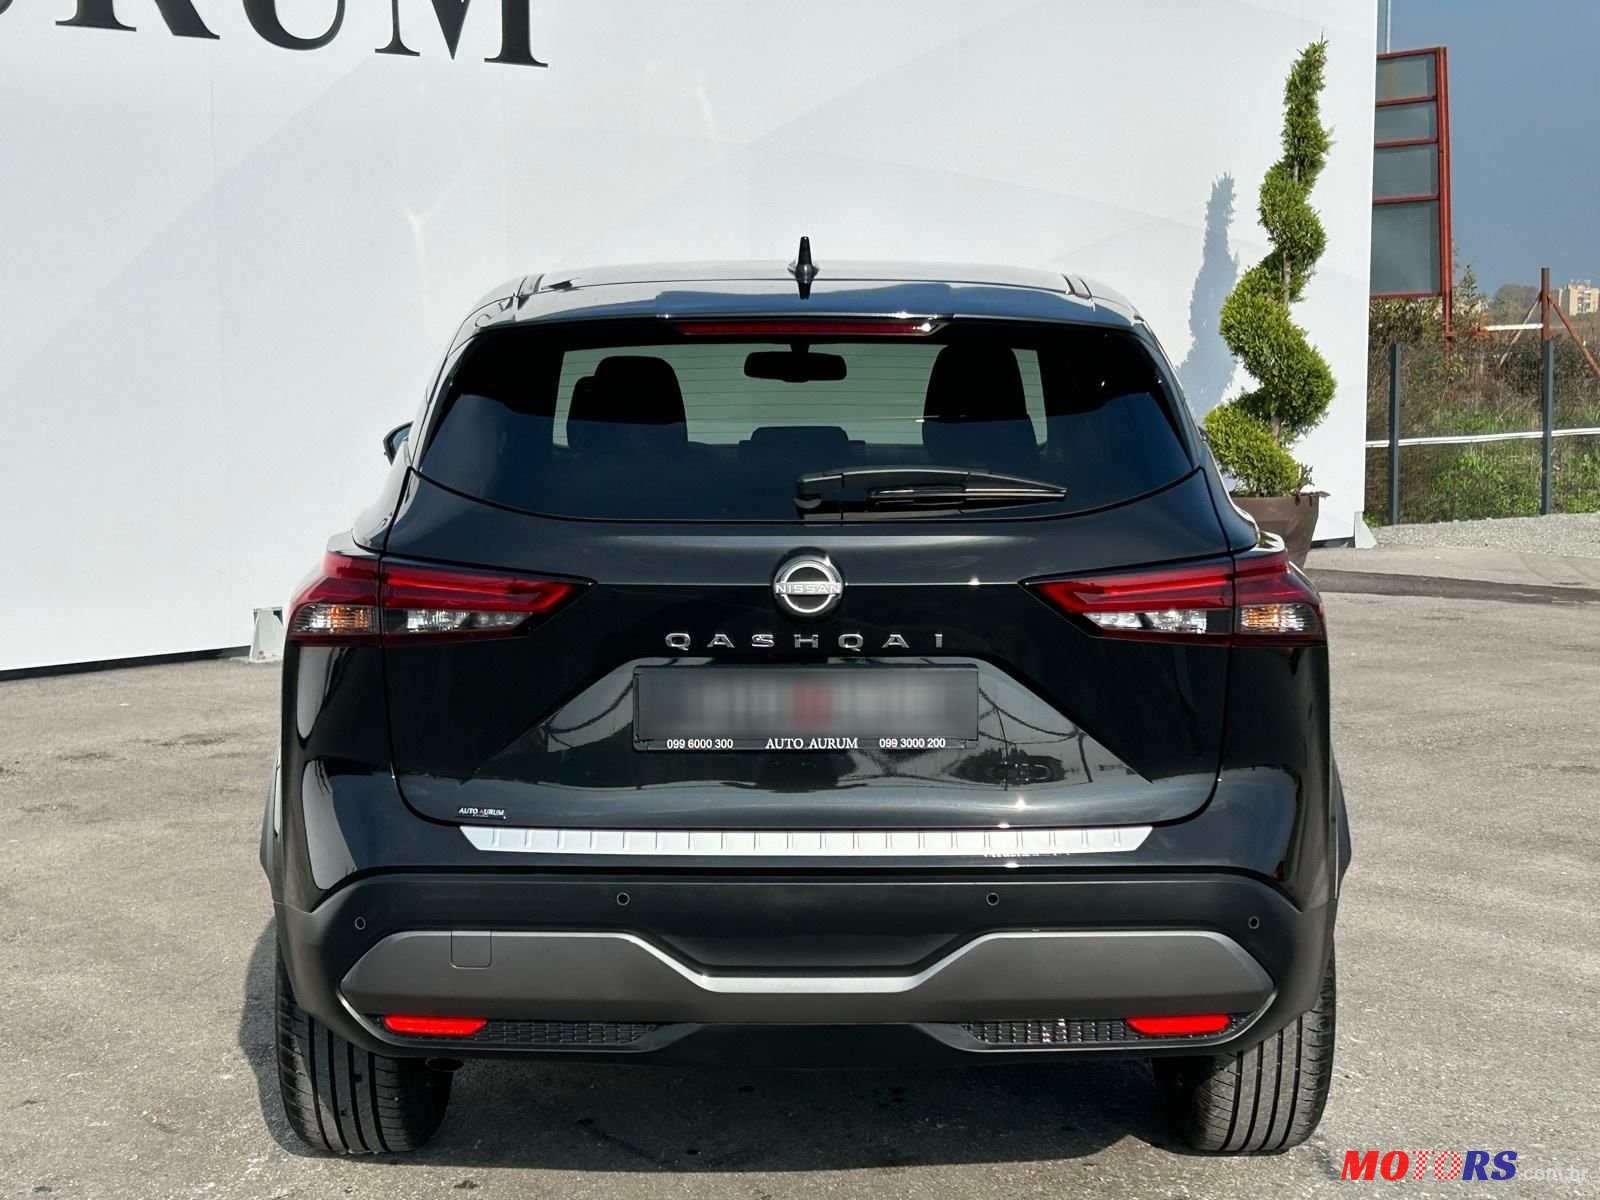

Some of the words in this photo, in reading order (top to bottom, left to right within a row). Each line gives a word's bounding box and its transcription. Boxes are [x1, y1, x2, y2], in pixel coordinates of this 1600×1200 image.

[776, 582, 841, 593] NISSAN
[665, 633, 944, 651] QASHQAI
[667, 739, 685, 749] 099
[688, 739, 712, 749] 6000
[715, 739, 734, 749] 300
[765, 738, 804, 749] AUTO
[808, 738, 858, 749] AURUM
[879, 738, 898, 748] 099
[900, 738, 925, 748] 3000
[927, 738, 946, 748] 200
